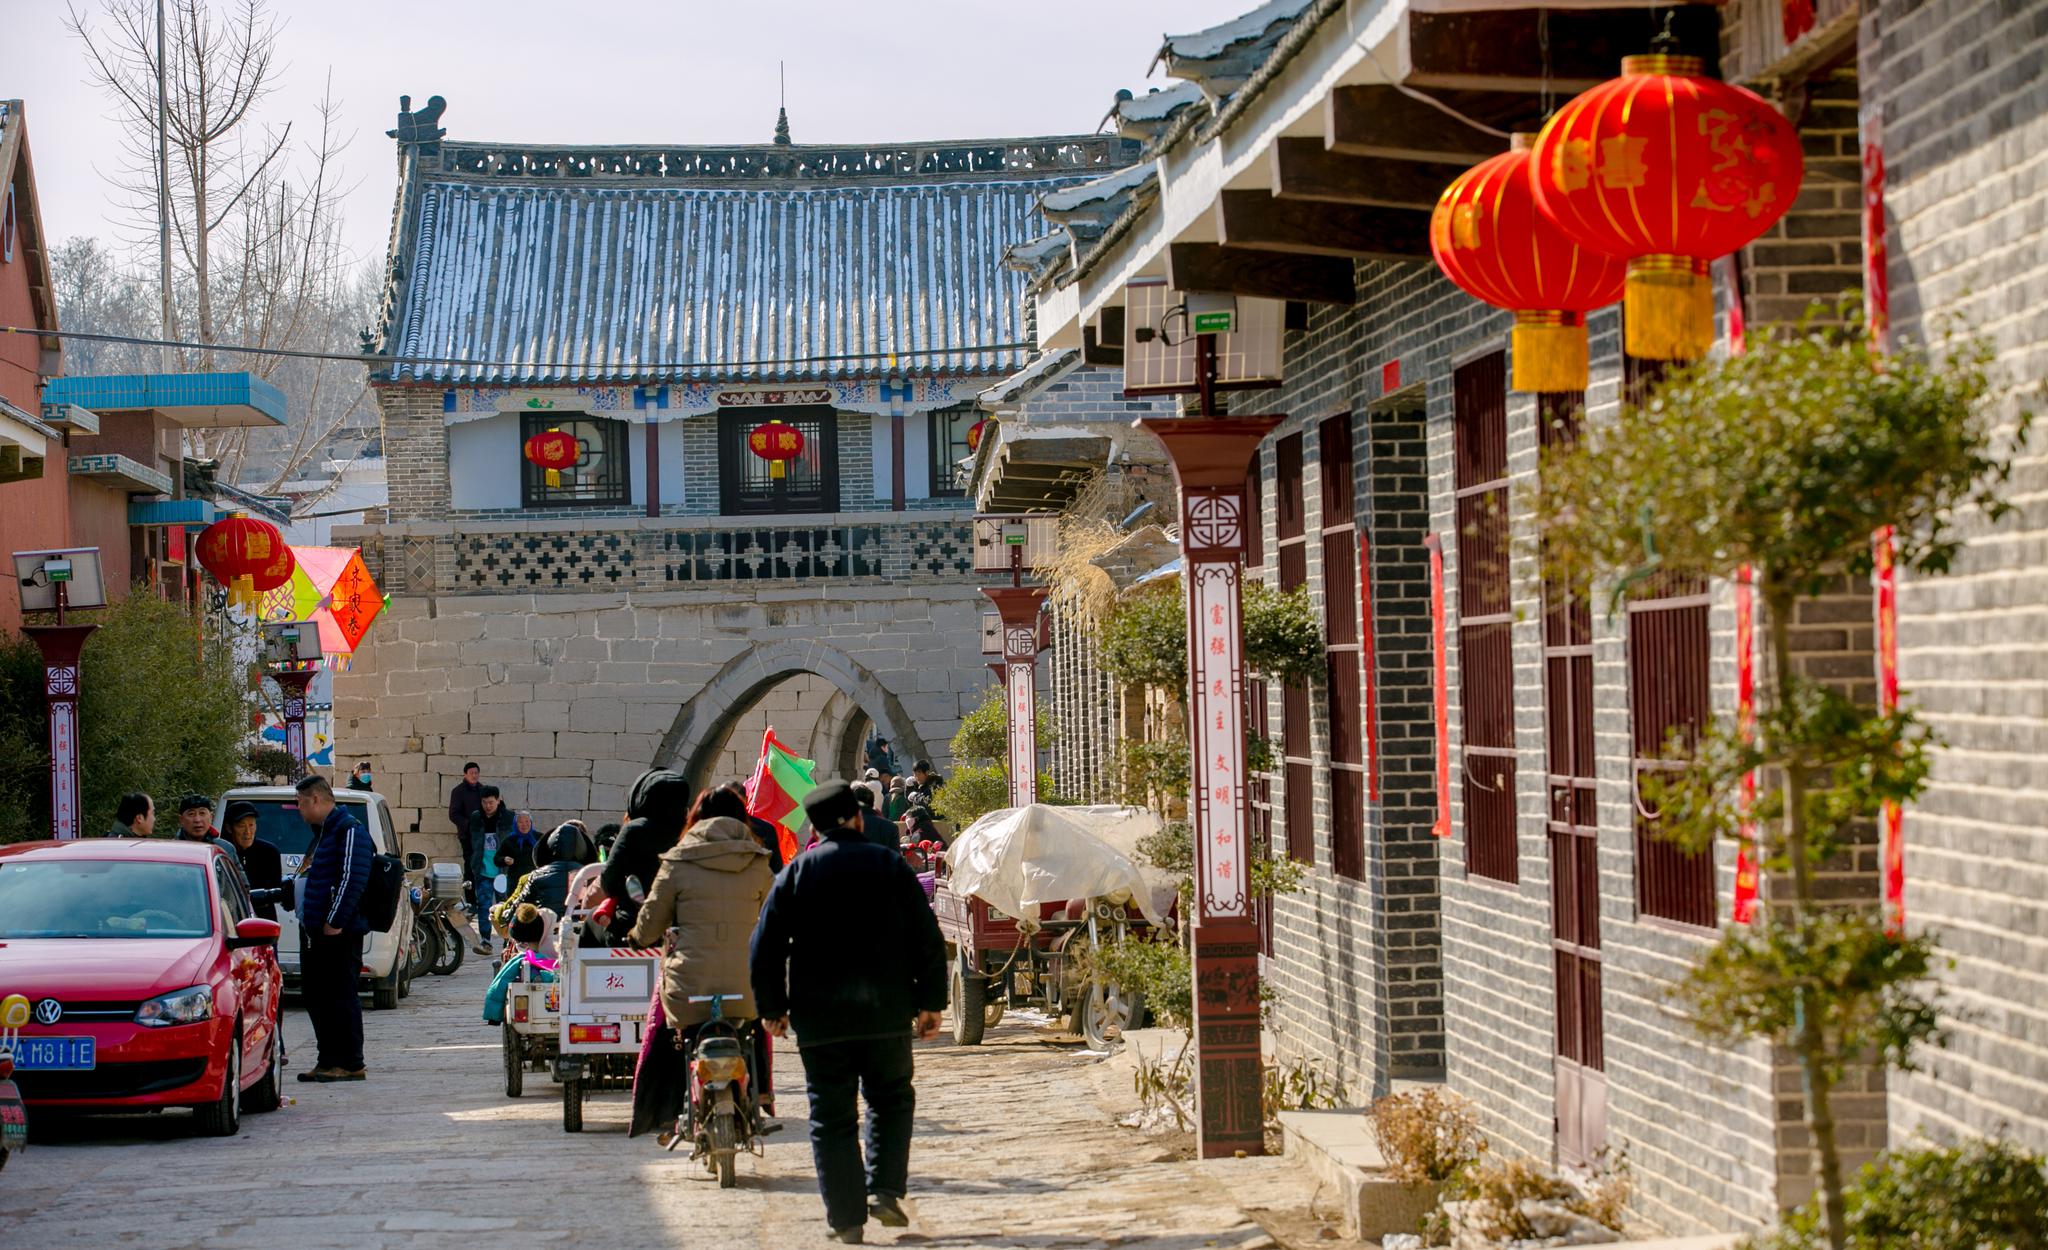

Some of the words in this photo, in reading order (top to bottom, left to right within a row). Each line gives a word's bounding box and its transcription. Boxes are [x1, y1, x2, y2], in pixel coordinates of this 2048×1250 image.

[1209, 603, 1233, 880] 富强民主文明和谐
[1, 1042, 91, 1064] AM811E
